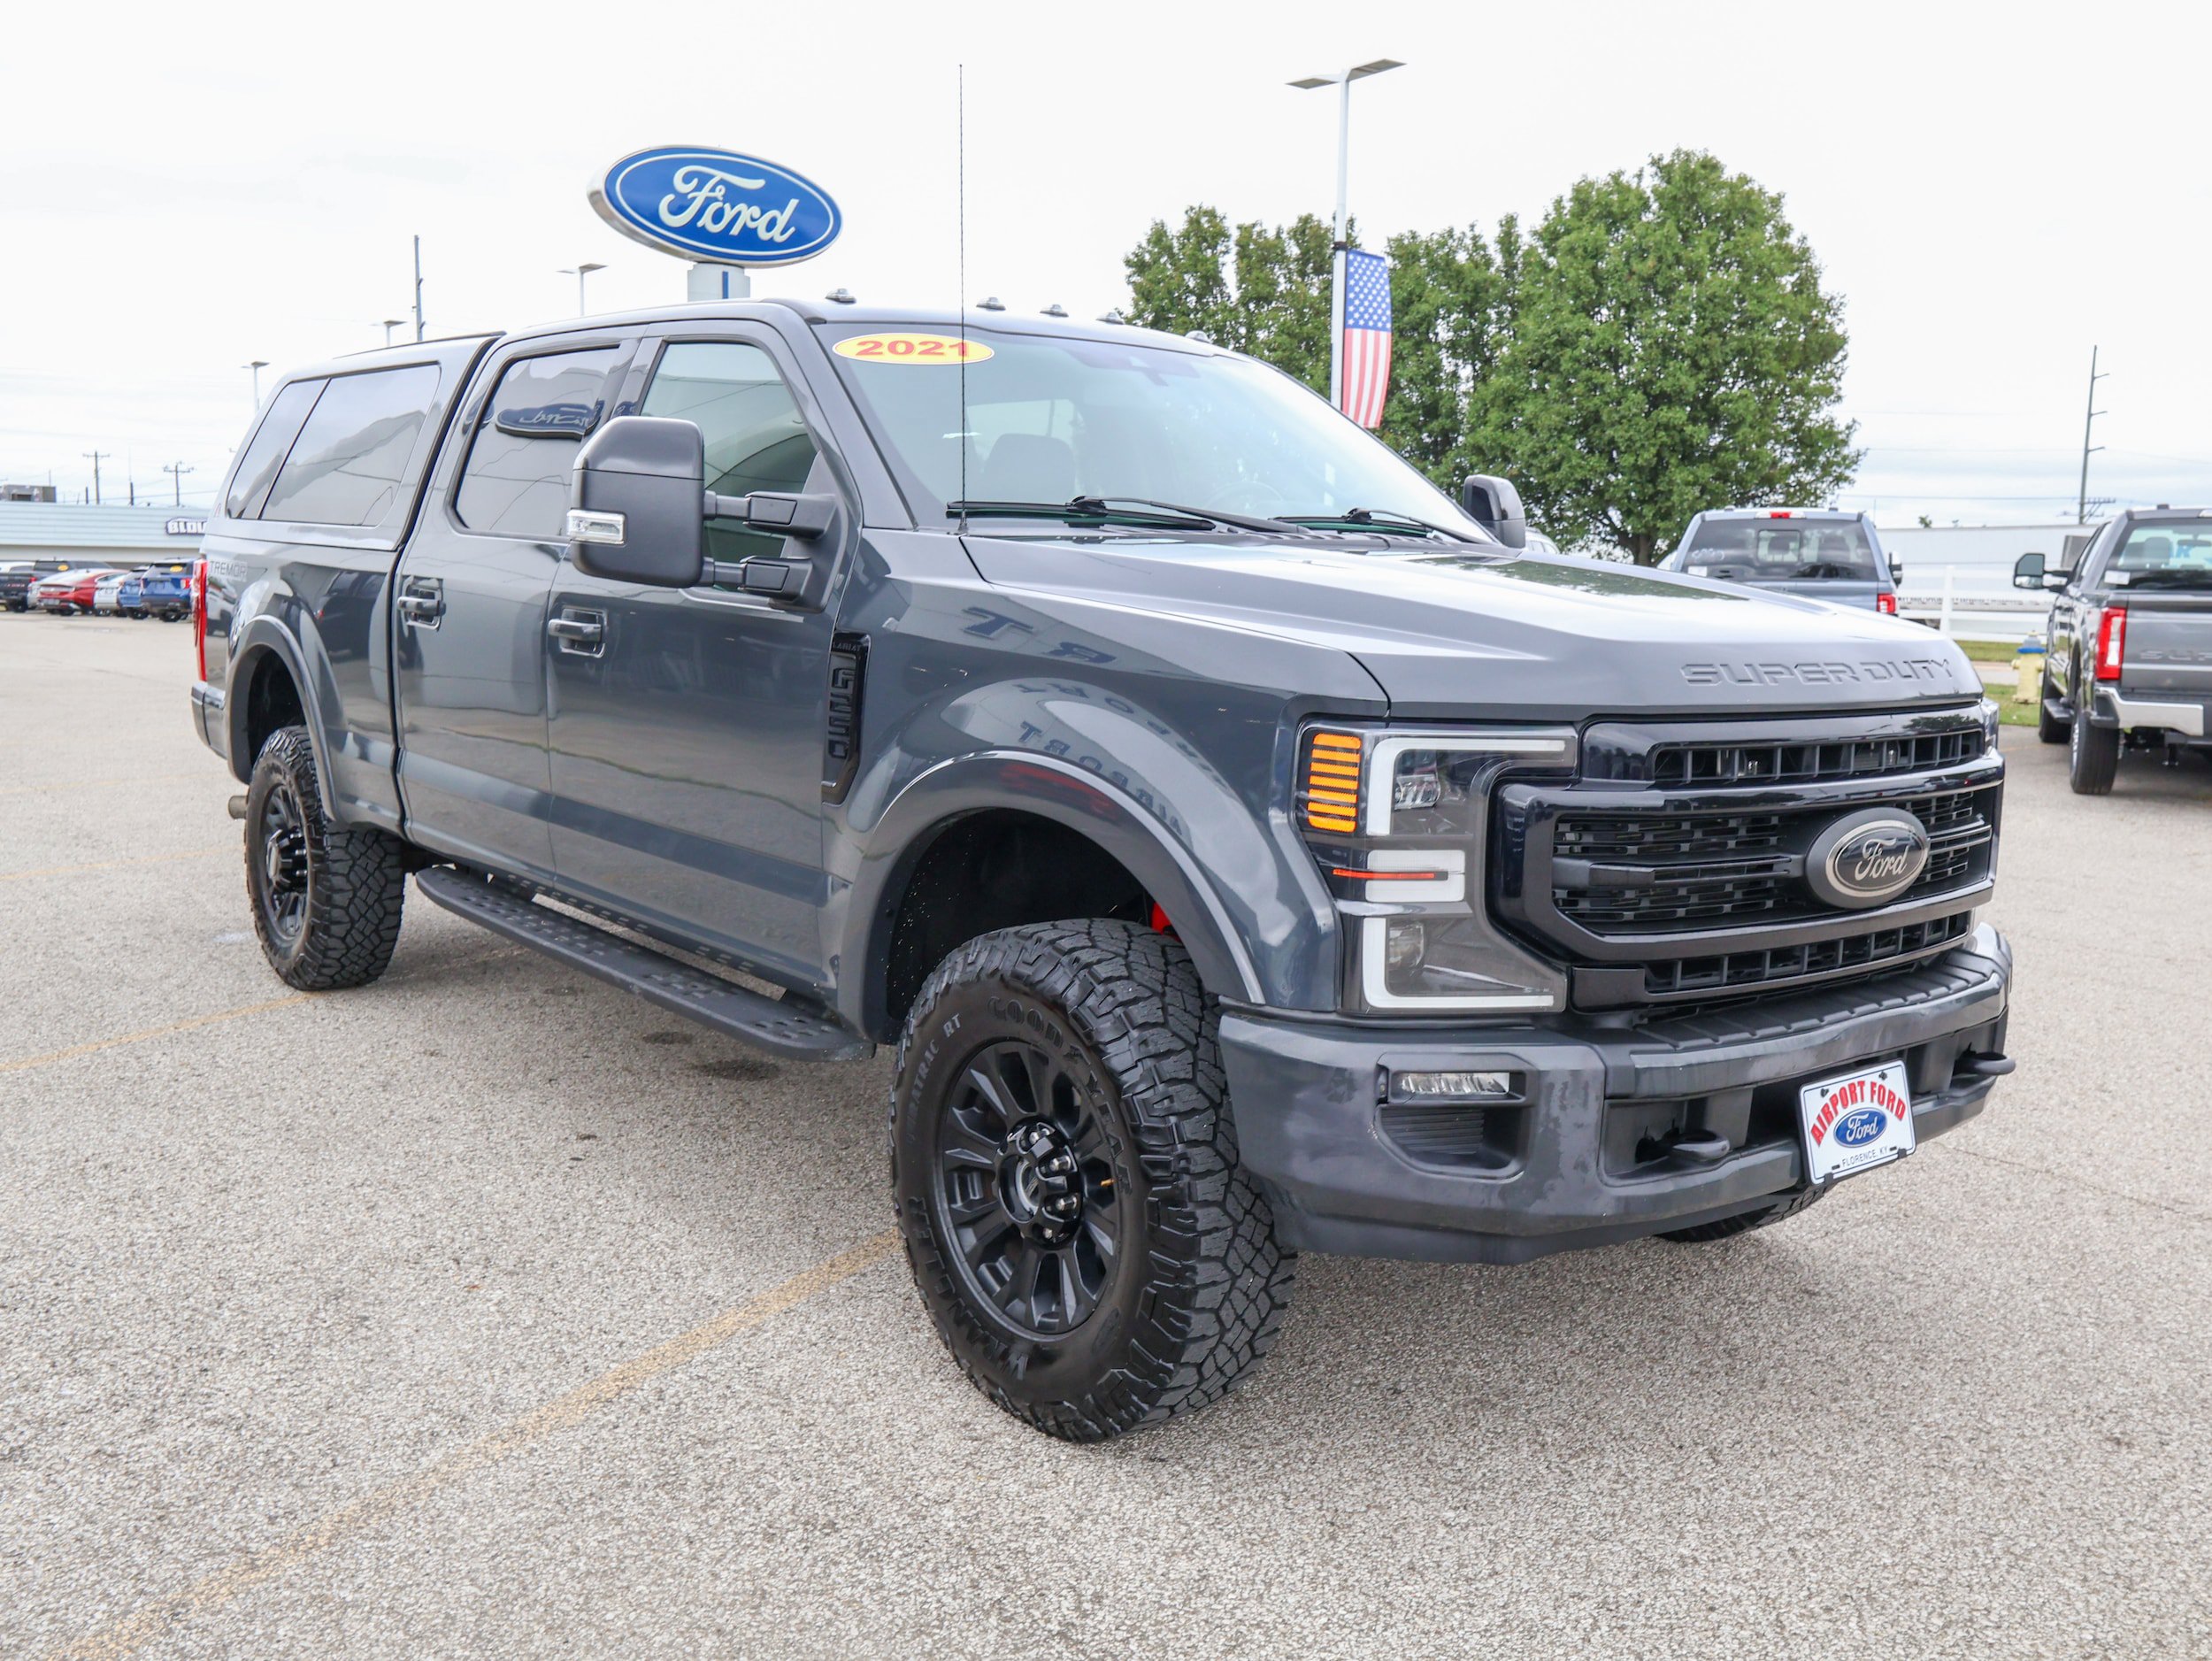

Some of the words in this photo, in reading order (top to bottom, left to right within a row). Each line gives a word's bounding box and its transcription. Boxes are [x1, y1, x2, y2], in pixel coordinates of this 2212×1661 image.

[658, 165, 799, 242] Ford
[855, 340, 969, 358] 2021
[210, 559, 248, 582] TREMOR
[1680, 662, 1862, 687] SUPER
[1863, 658, 1953, 681] DUTY
[1855, 837, 1909, 881] Ford
[943, 1012, 962, 1038] RT
[1810, 1080, 1866, 1148] AIRPORT
[1870, 1080, 1907, 1121] FORD
[1846, 1112, 1878, 1142] Ford
[1879, 1146, 1889, 1157] KY
